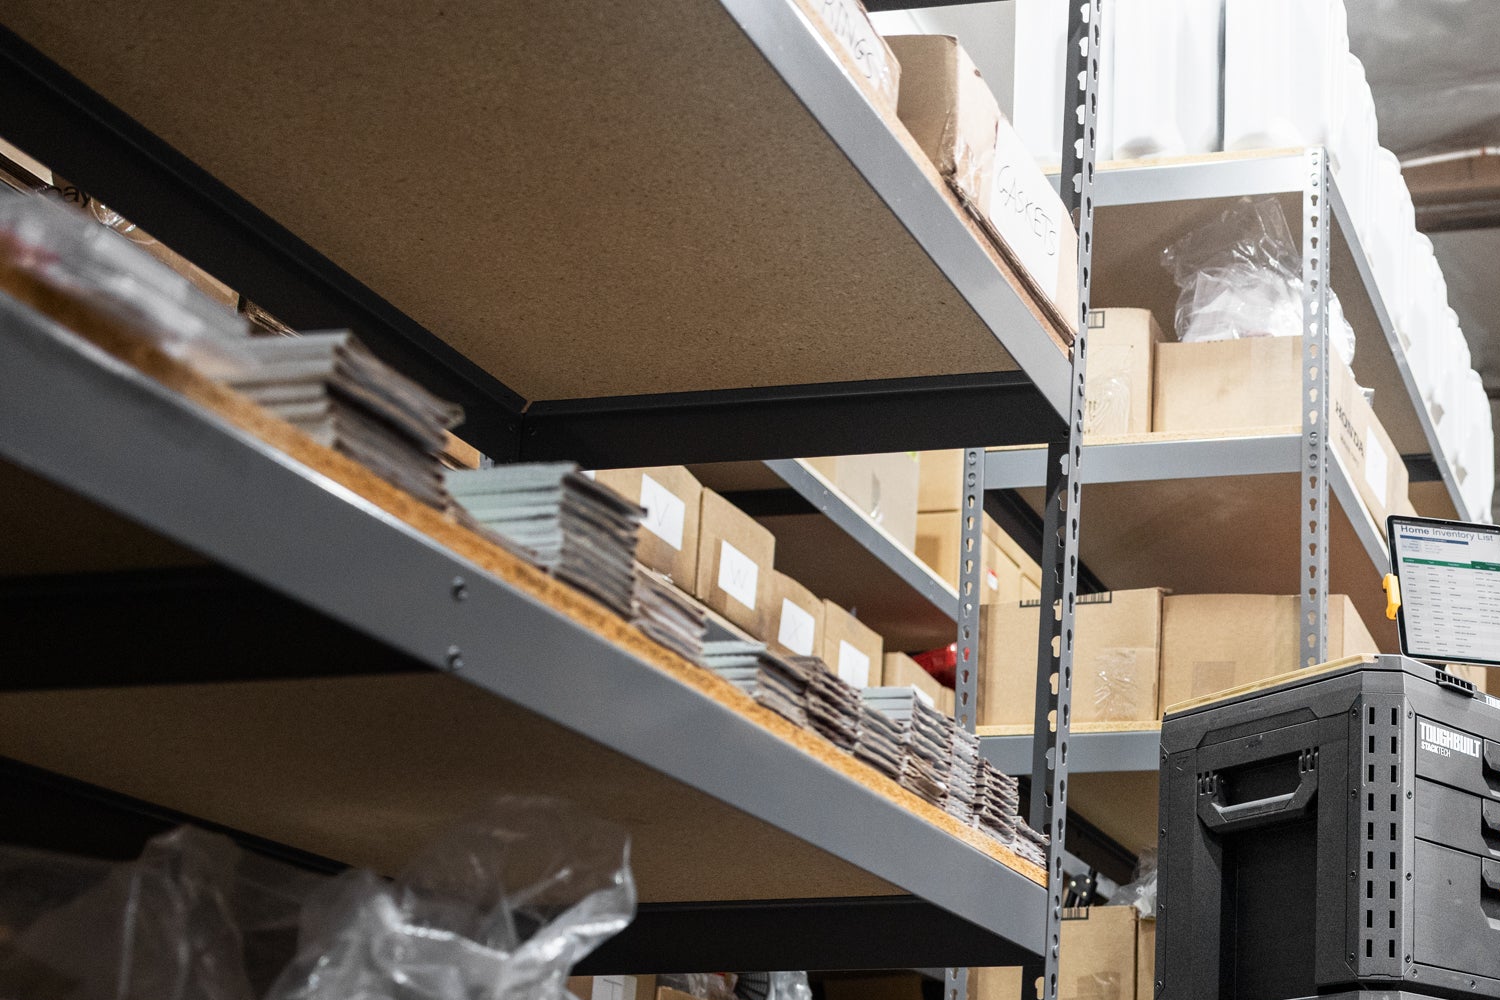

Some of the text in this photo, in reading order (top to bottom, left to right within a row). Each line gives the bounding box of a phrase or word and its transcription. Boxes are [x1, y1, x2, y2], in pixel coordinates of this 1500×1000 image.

[996, 164, 1057, 257] GASKETS
[1335, 399, 1365, 458] HONDA
[1400, 525, 1430, 535] Home
[1432, 528, 1475, 541] Inventory
[1477, 533, 1493, 542] List
[1420, 721, 1480, 758] TOUGHBUILT
